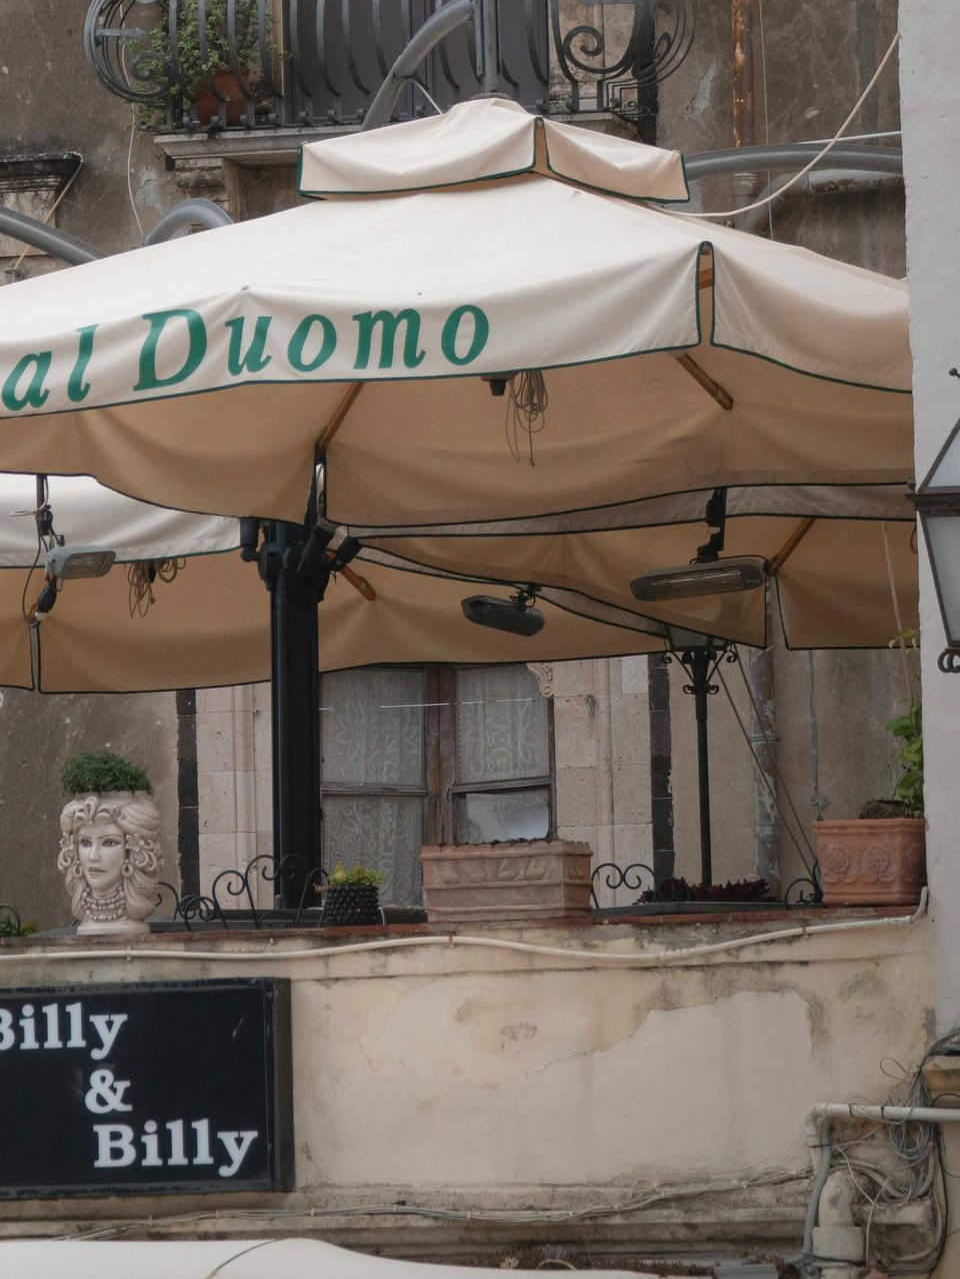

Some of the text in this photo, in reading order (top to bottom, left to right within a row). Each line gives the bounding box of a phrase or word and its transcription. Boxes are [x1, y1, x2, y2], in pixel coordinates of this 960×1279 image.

[1, 304, 490, 411] al Duomo
[85, 1069, 132, 1114] &
[93, 1118, 259, 1177] Billy
